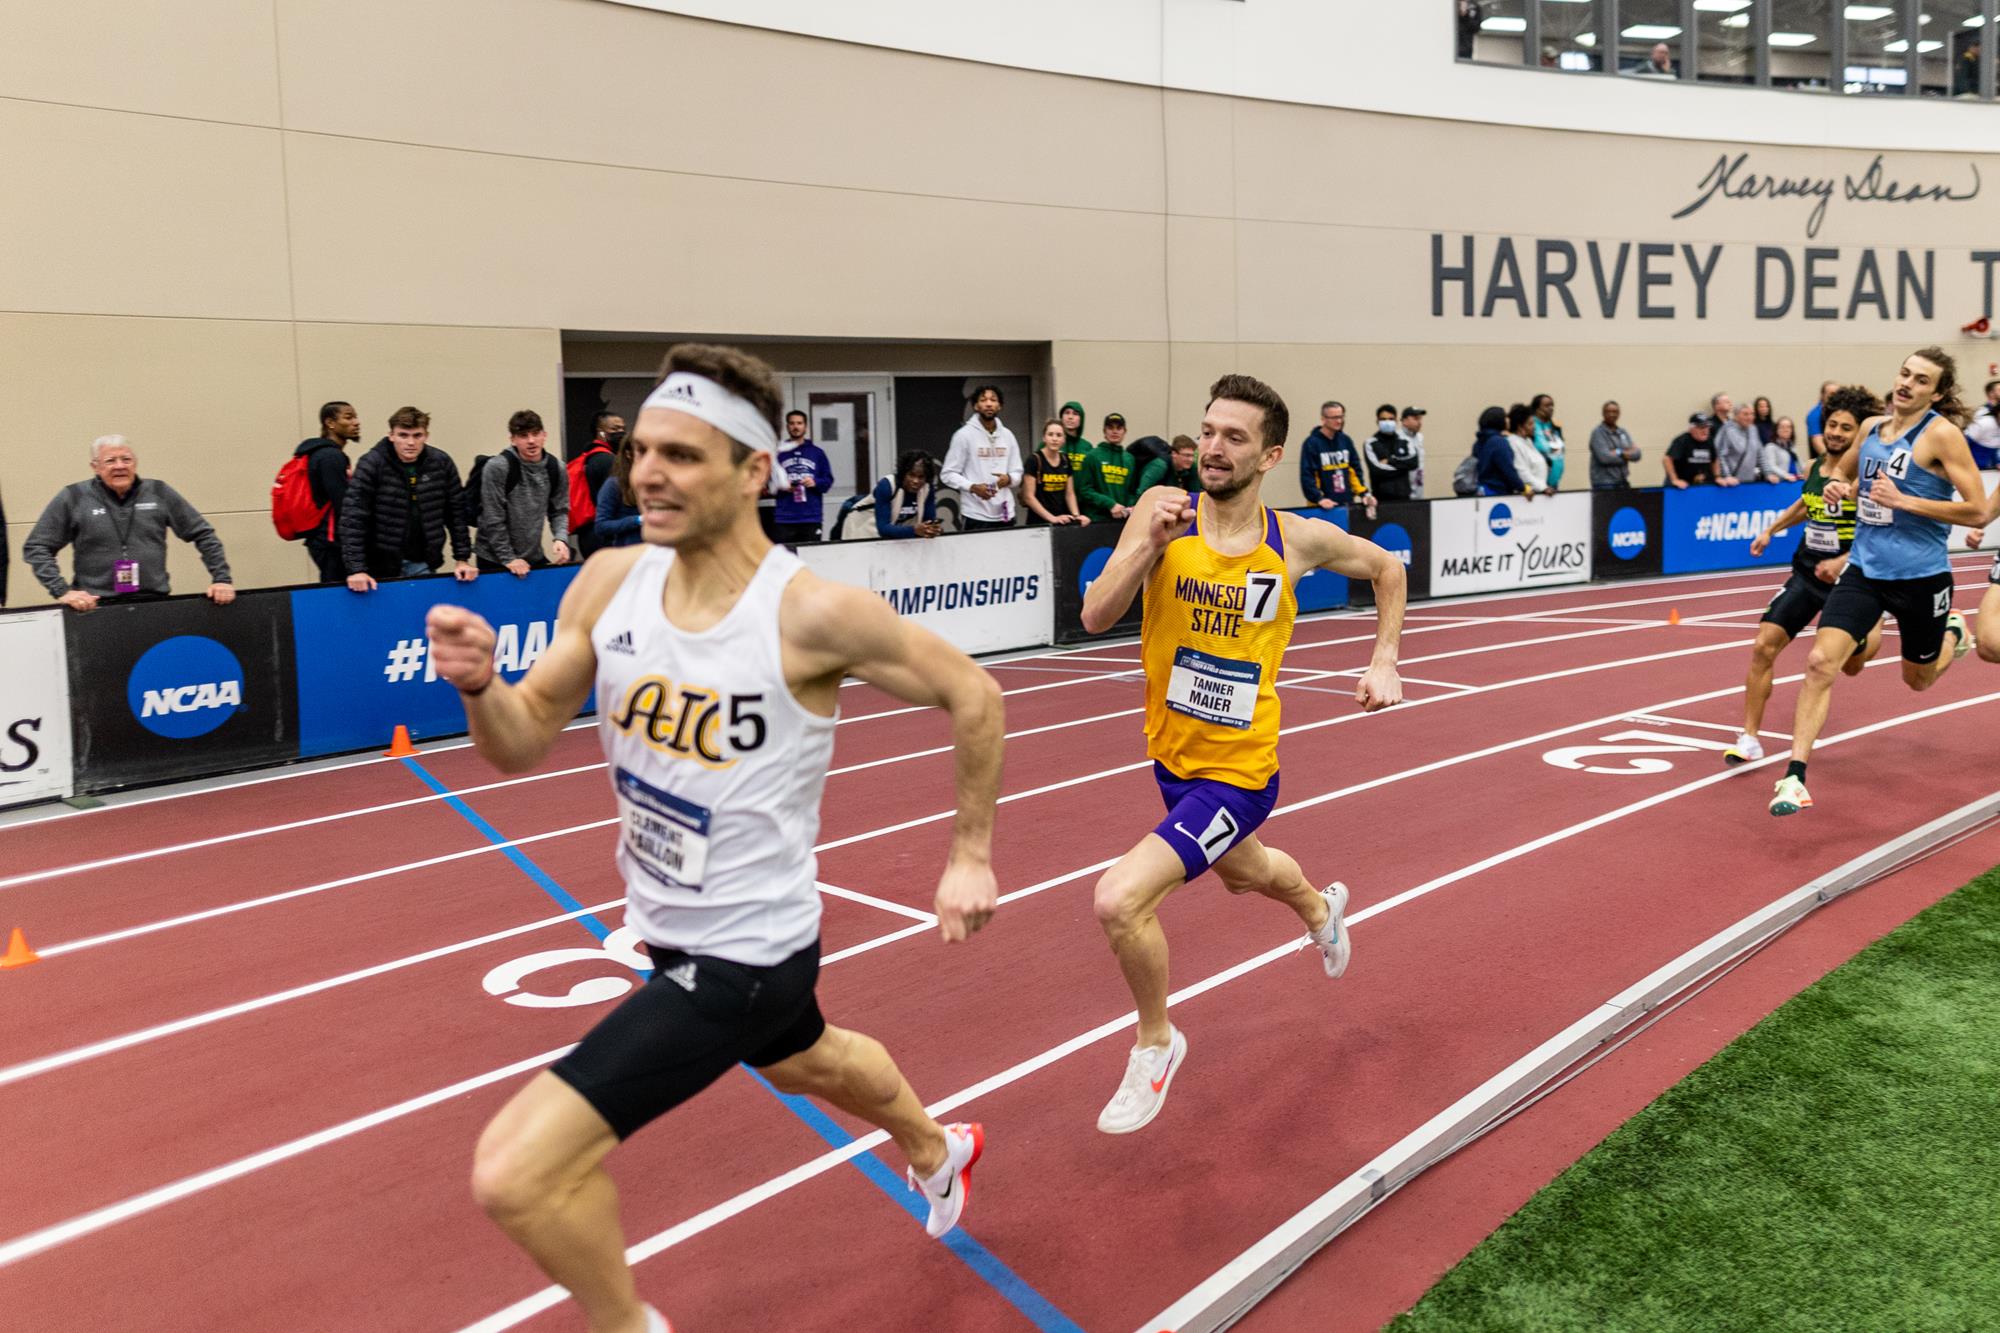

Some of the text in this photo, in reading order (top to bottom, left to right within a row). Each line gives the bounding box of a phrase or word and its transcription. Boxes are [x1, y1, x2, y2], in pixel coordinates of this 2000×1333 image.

[1672, 153, 1981, 239] Harvey Dean
[1431, 234, 1723, 319] HARVEY
[1754, 246, 1935, 320] DEAN
[1890, 452, 1906, 476] 4
[1612, 530, 1646, 548] NCAA
[1441, 534, 1586, 582] MAKE IT YOURS
[873, 574, 1040, 616] AMPIONSHIPS
[1175, 575, 1247, 612] MINNESO
[1252, 577, 1277, 619] 7
[1937, 592, 1948, 611] 4
[1191, 608, 1243, 638] STATE
[141, 680, 241, 717] NCAA
[1189, 690, 1232, 713] MAIER
[1193, 676, 1234, 697] TANNER
[728, 693, 767, 752] 5
[1204, 812, 1236, 851] 7
